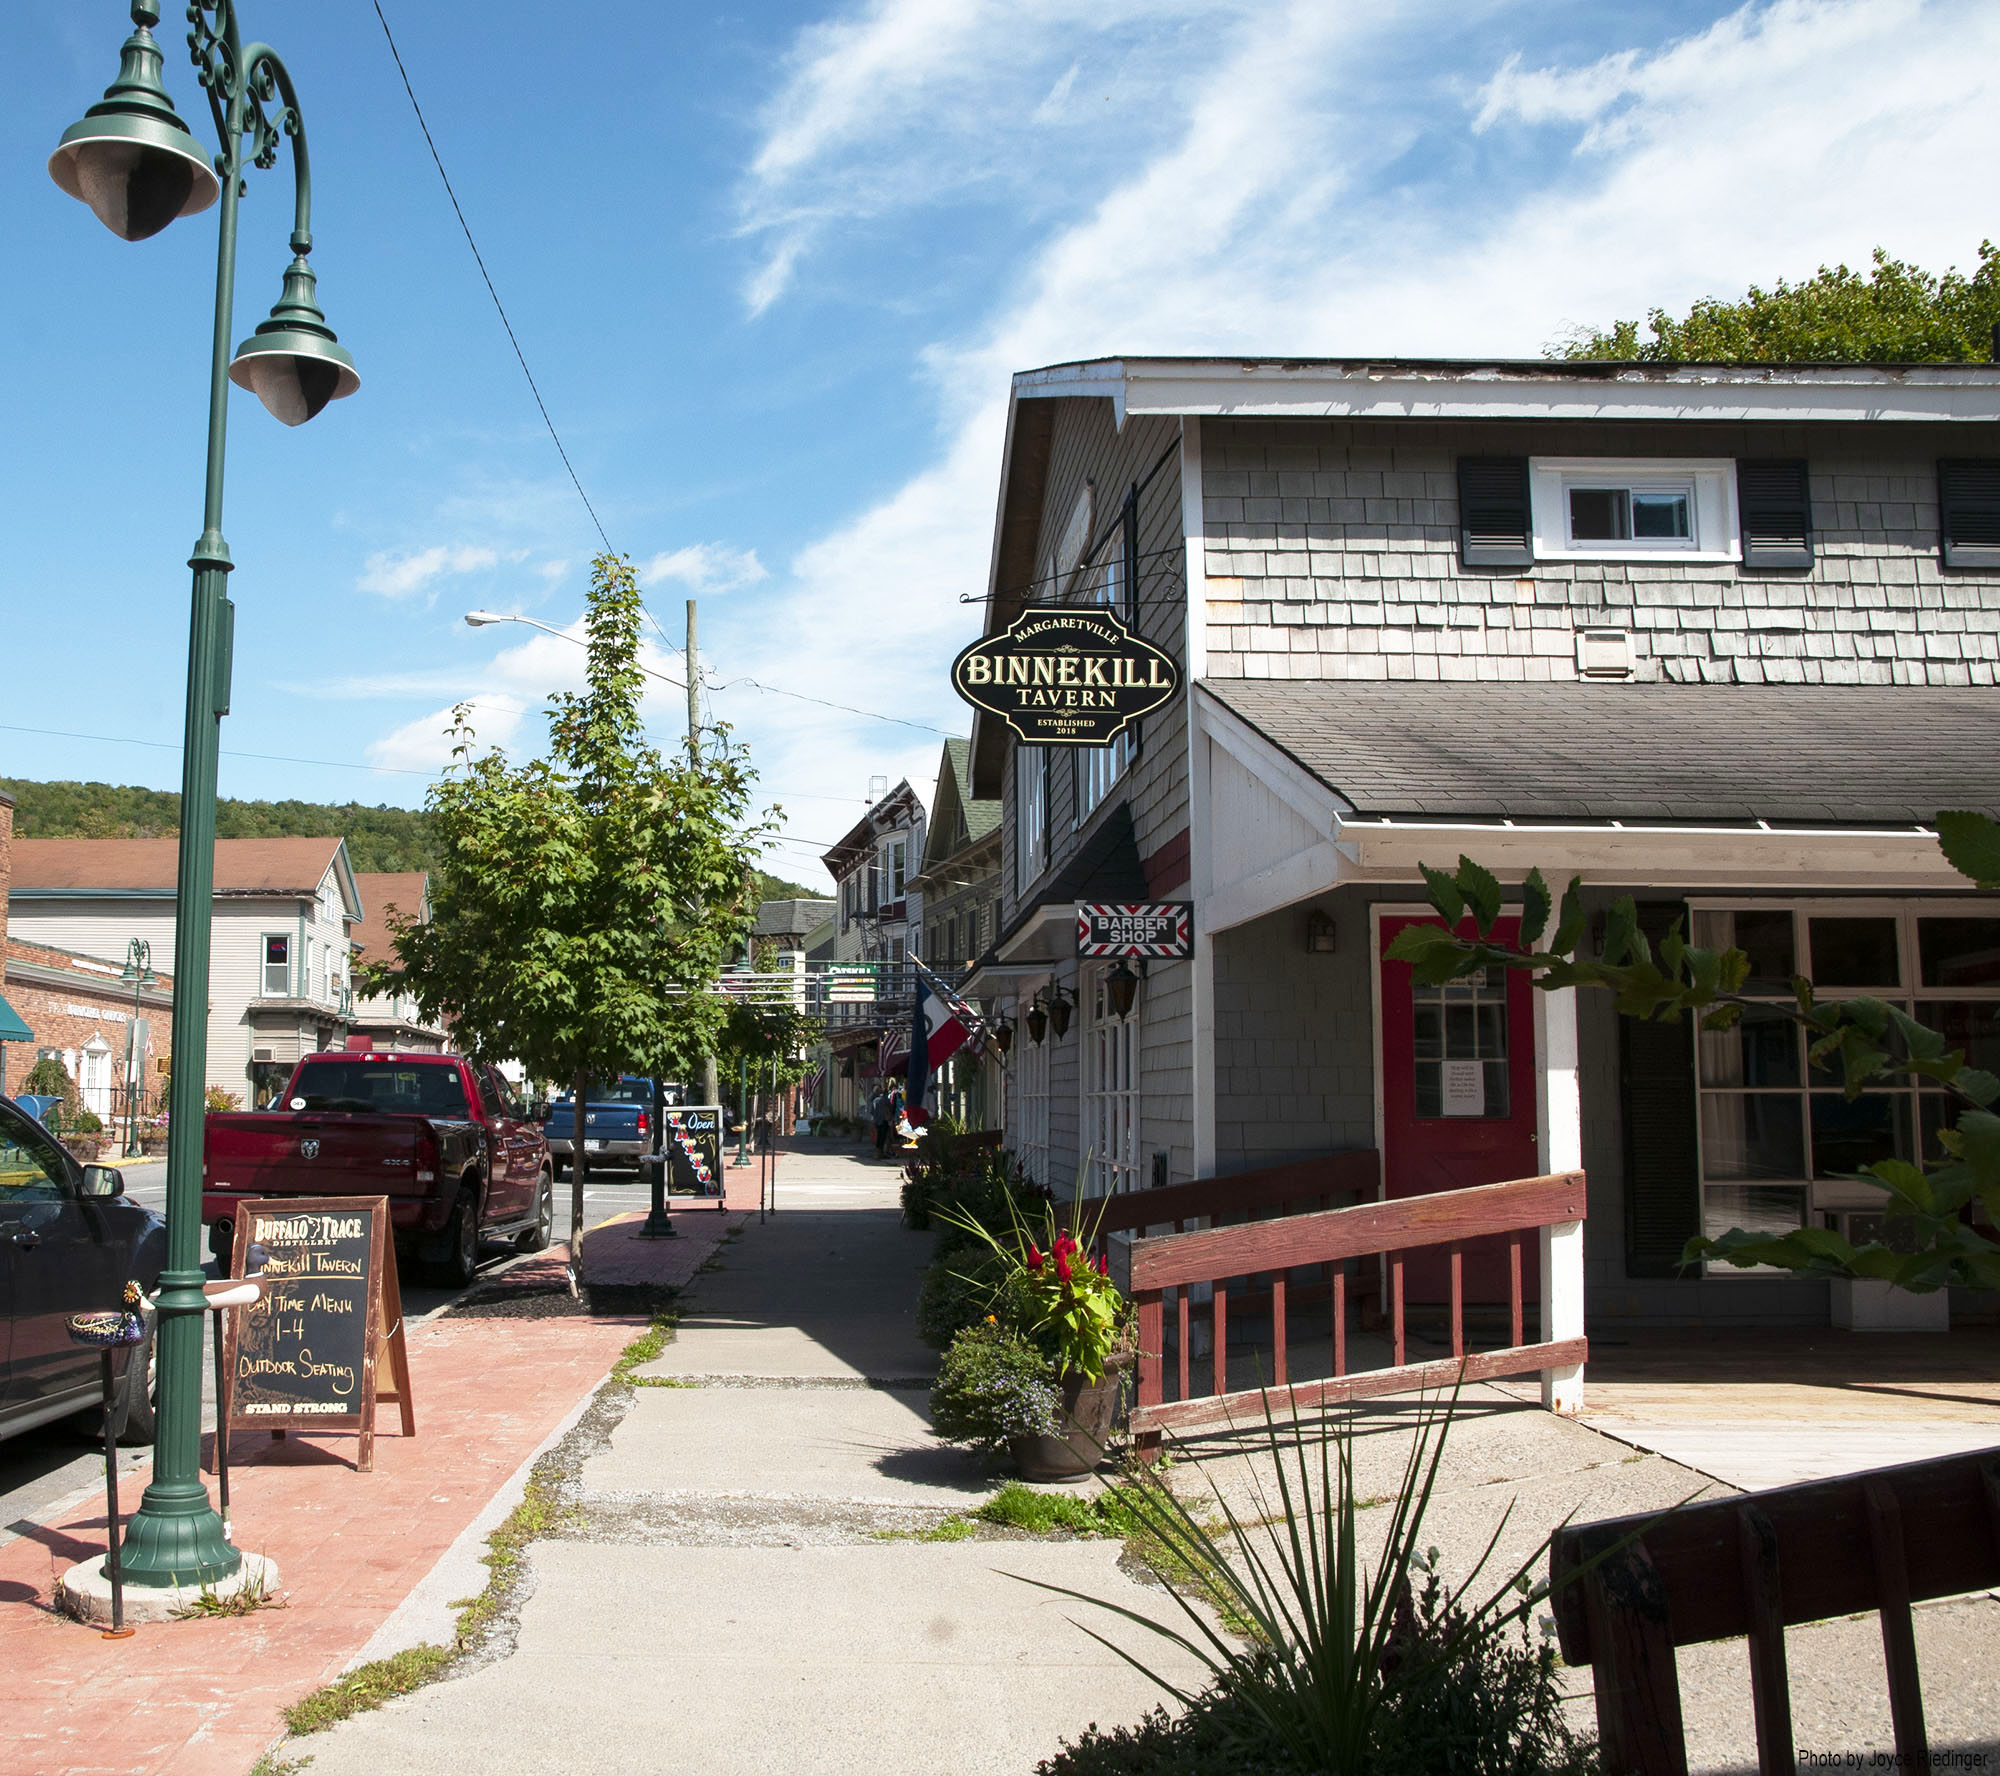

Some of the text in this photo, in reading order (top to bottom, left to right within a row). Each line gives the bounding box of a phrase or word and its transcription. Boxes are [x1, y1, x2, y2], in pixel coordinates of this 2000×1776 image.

[1015, 618, 1119, 645] MARGARETVILLE
[967, 655, 1172, 688] BINNEKILL
[1016, 688, 1116, 707] TAVERN
[1037, 718, 1096, 728] ESTABLISHED
[1056, 727, 1076, 736] 2018
[1098, 918, 1167, 930] BARBER
[1110, 930, 1157, 943] SHOP
[687, 1112, 715, 1133] Open
[254, 1218, 309, 1242] BUFFALO
[272, 1239, 338, 1247] DISTILLERY
[311, 1252, 362, 1273] TAVERN
[274, 1295, 305, 1312] TIME
[310, 1293, 353, 1313] MENU
[276, 1318, 305, 1341] 1-4
[240, 1355, 297, 1378] OUTDOOR
[245, 1402, 348, 1414] STAND STRONG
